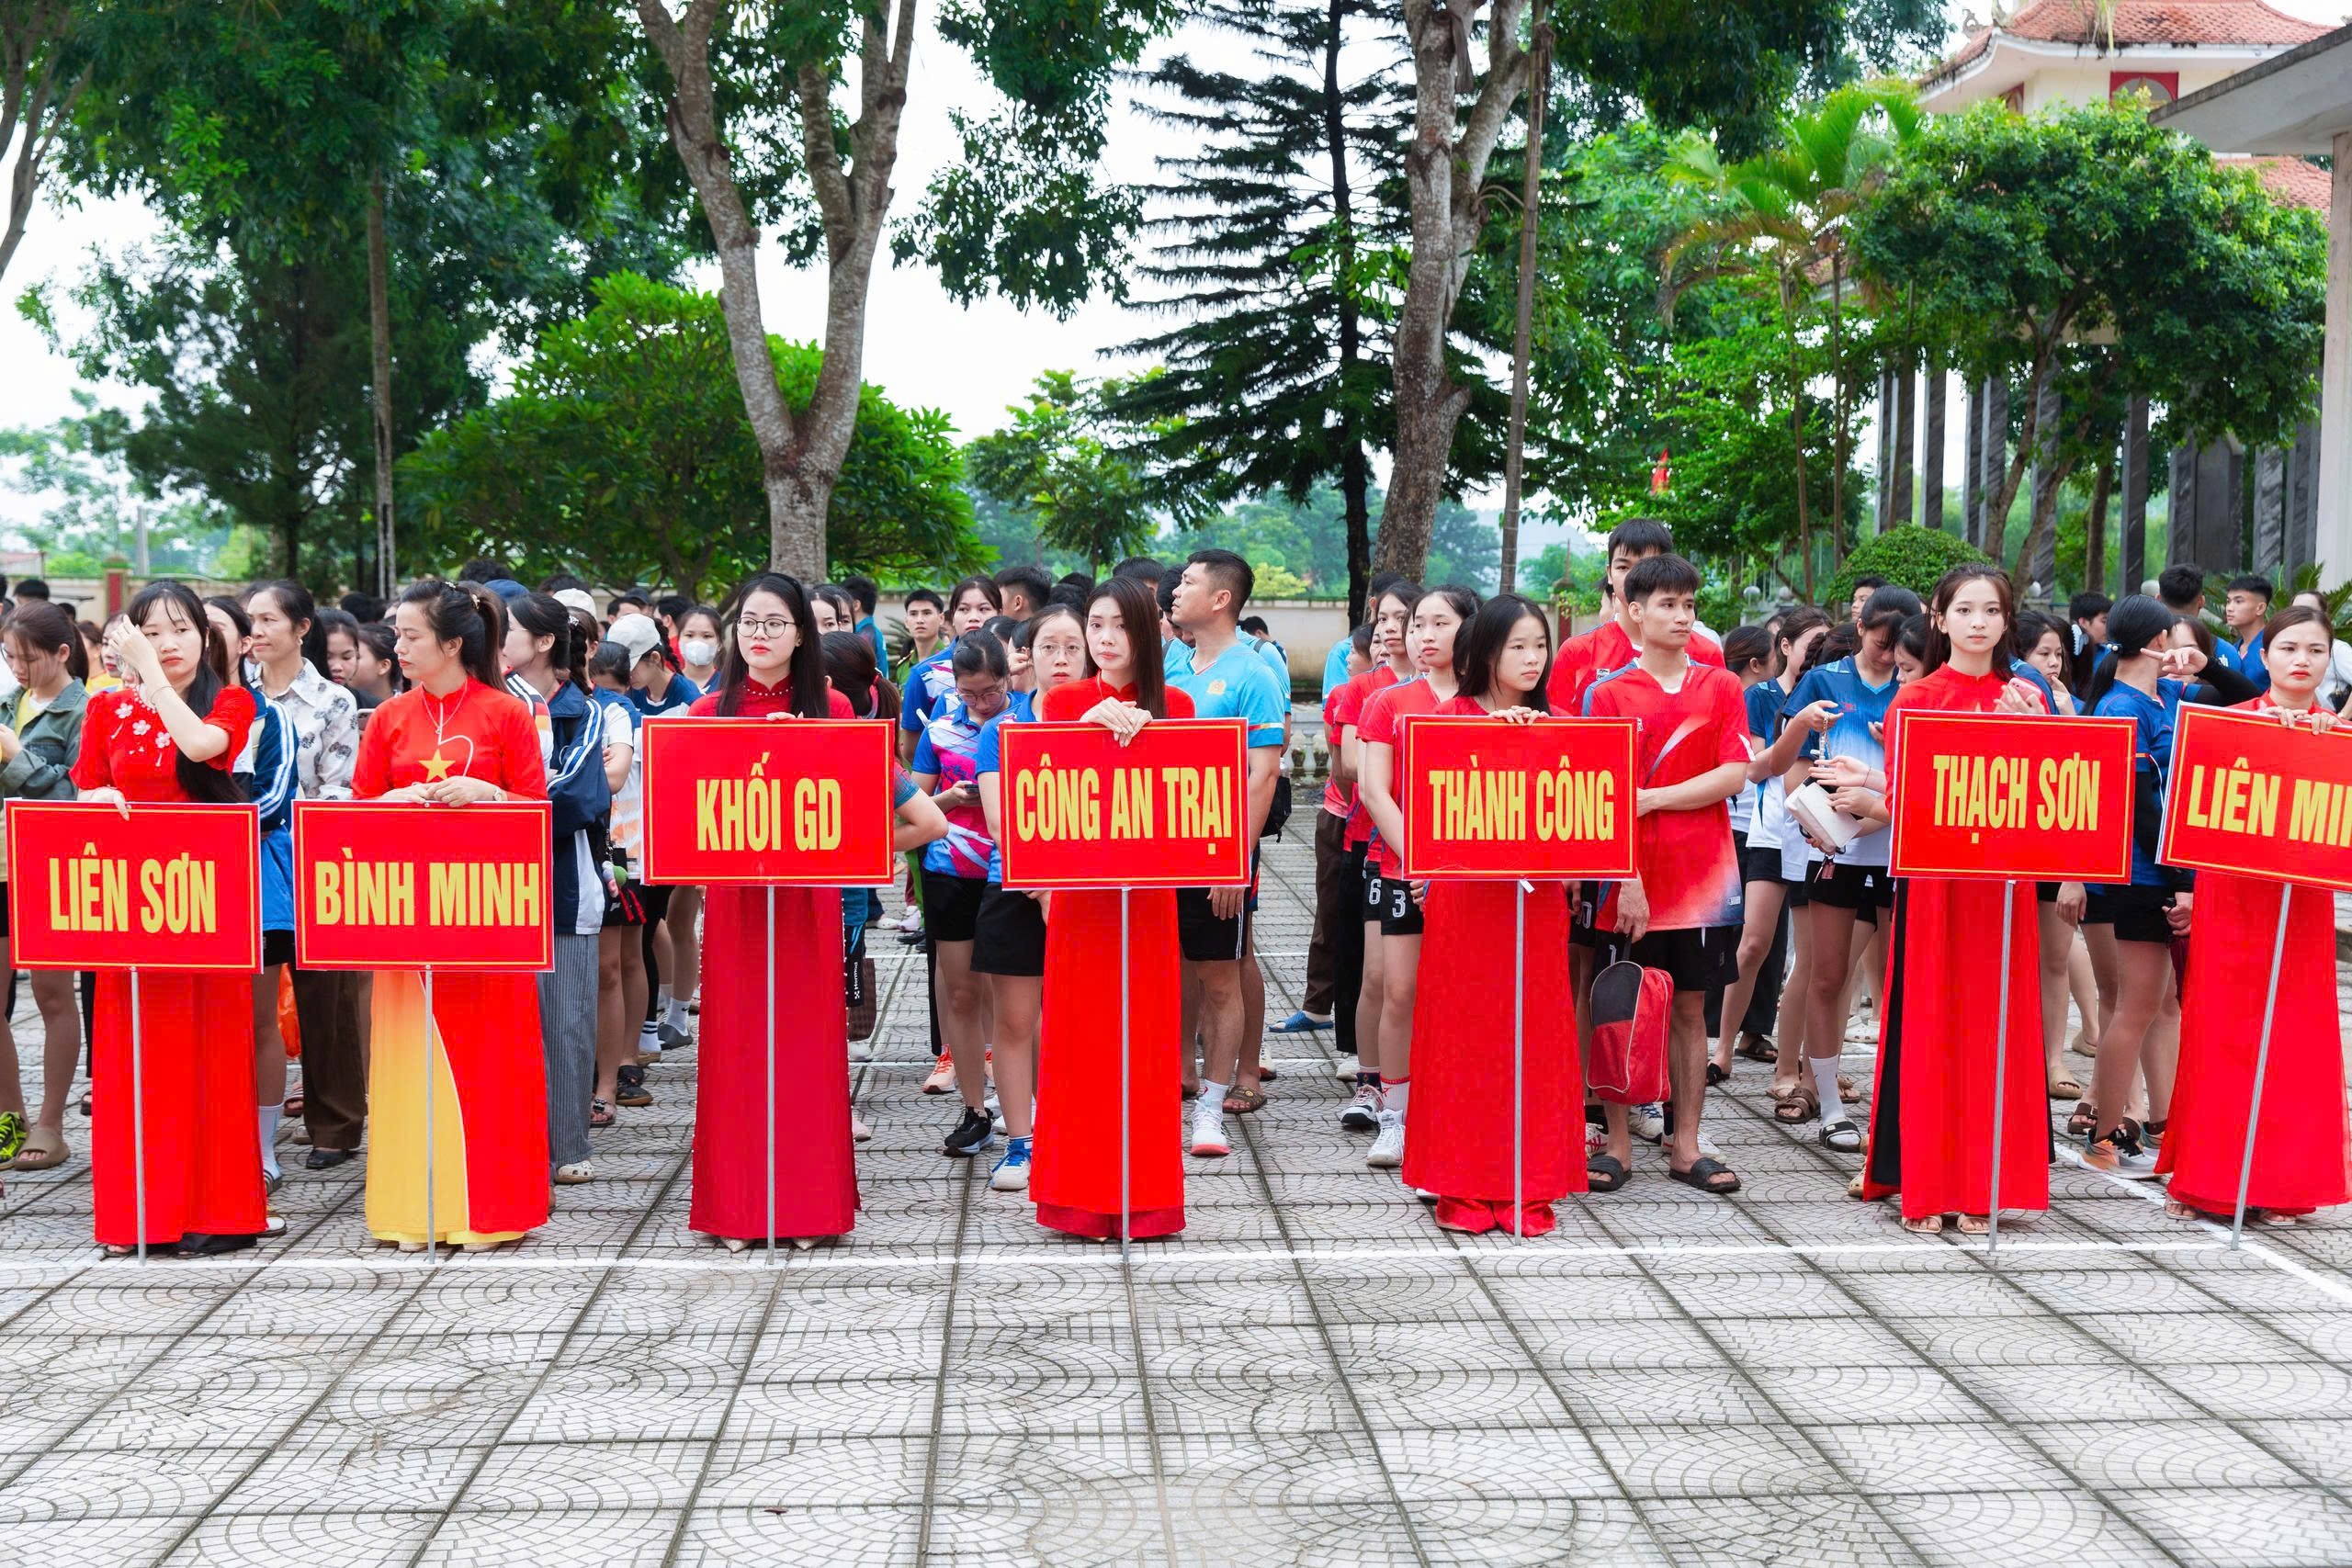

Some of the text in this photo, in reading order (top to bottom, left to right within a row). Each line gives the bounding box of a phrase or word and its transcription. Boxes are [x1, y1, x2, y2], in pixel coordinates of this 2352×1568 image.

[697, 752, 842, 852] KHỐI GD
[1015, 753, 1231, 854] CÔNG AN TRẠI
[1430, 755, 1614, 840] THÀNH CÔNG
[1933, 752, 2100, 843] THẠCH SƠN
[2187, 757, 2281, 836] LIÊN
[50, 842, 216, 933] LIÊN SƠN
[315, 848, 540, 926] BÌNH MINH
[1369, 878, 1382, 905] 6
[1392, 889, 1407, 918] 3
